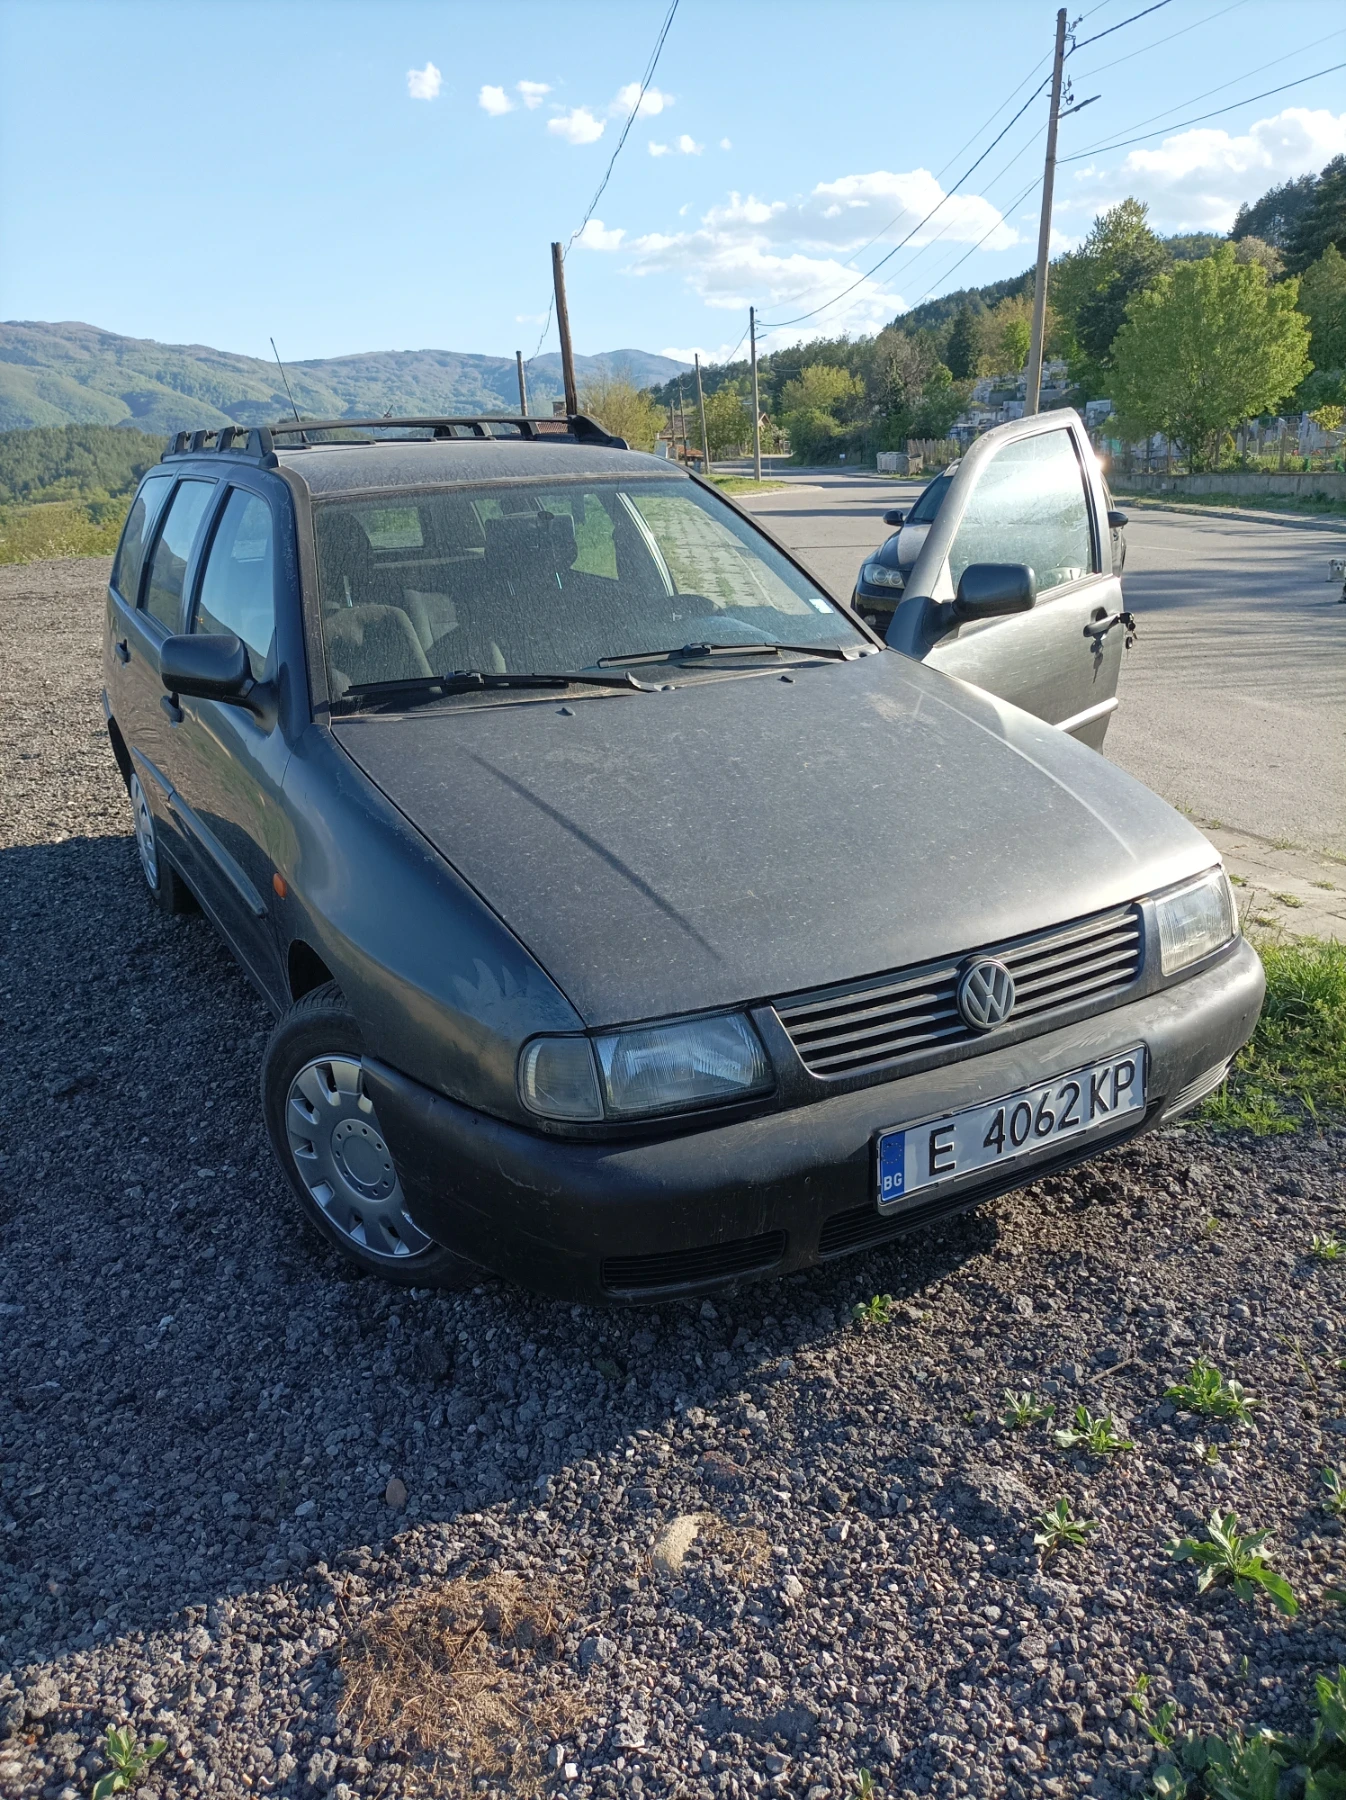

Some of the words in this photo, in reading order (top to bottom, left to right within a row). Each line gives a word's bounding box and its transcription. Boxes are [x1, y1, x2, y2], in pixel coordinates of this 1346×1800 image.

[960, 960, 1014, 1029] VW
[928, 1123, 956, 1176] E
[982, 1080, 1081, 1154] 4062
[1089, 1058, 1136, 1120] KP
[883, 1172, 903, 1191] BG
